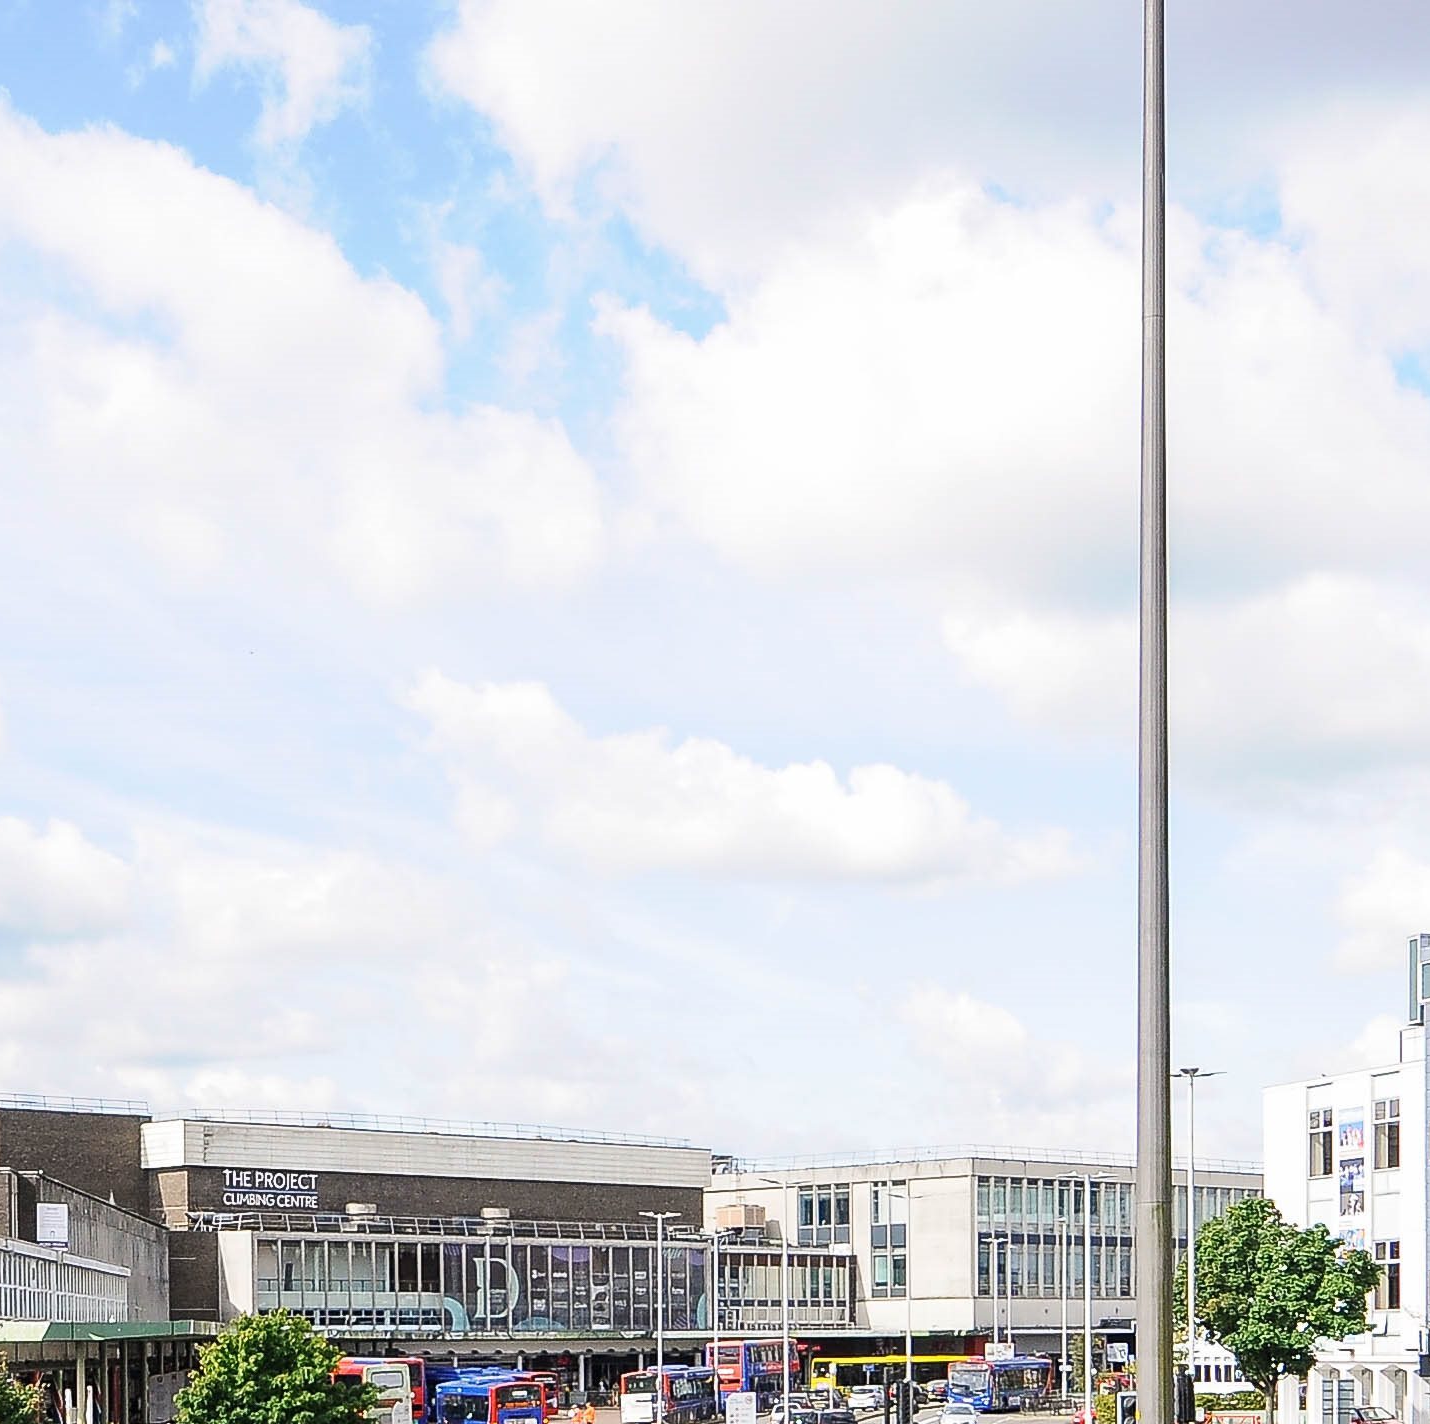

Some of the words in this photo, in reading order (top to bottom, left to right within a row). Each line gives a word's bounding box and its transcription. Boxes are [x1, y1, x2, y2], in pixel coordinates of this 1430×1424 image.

[222, 1168, 252, 1187] THE
[255, 1170, 319, 1190] PROJECT
[222, 1192, 275, 1206] CLIMBING
[276, 1194, 319, 1208] CENTRE
